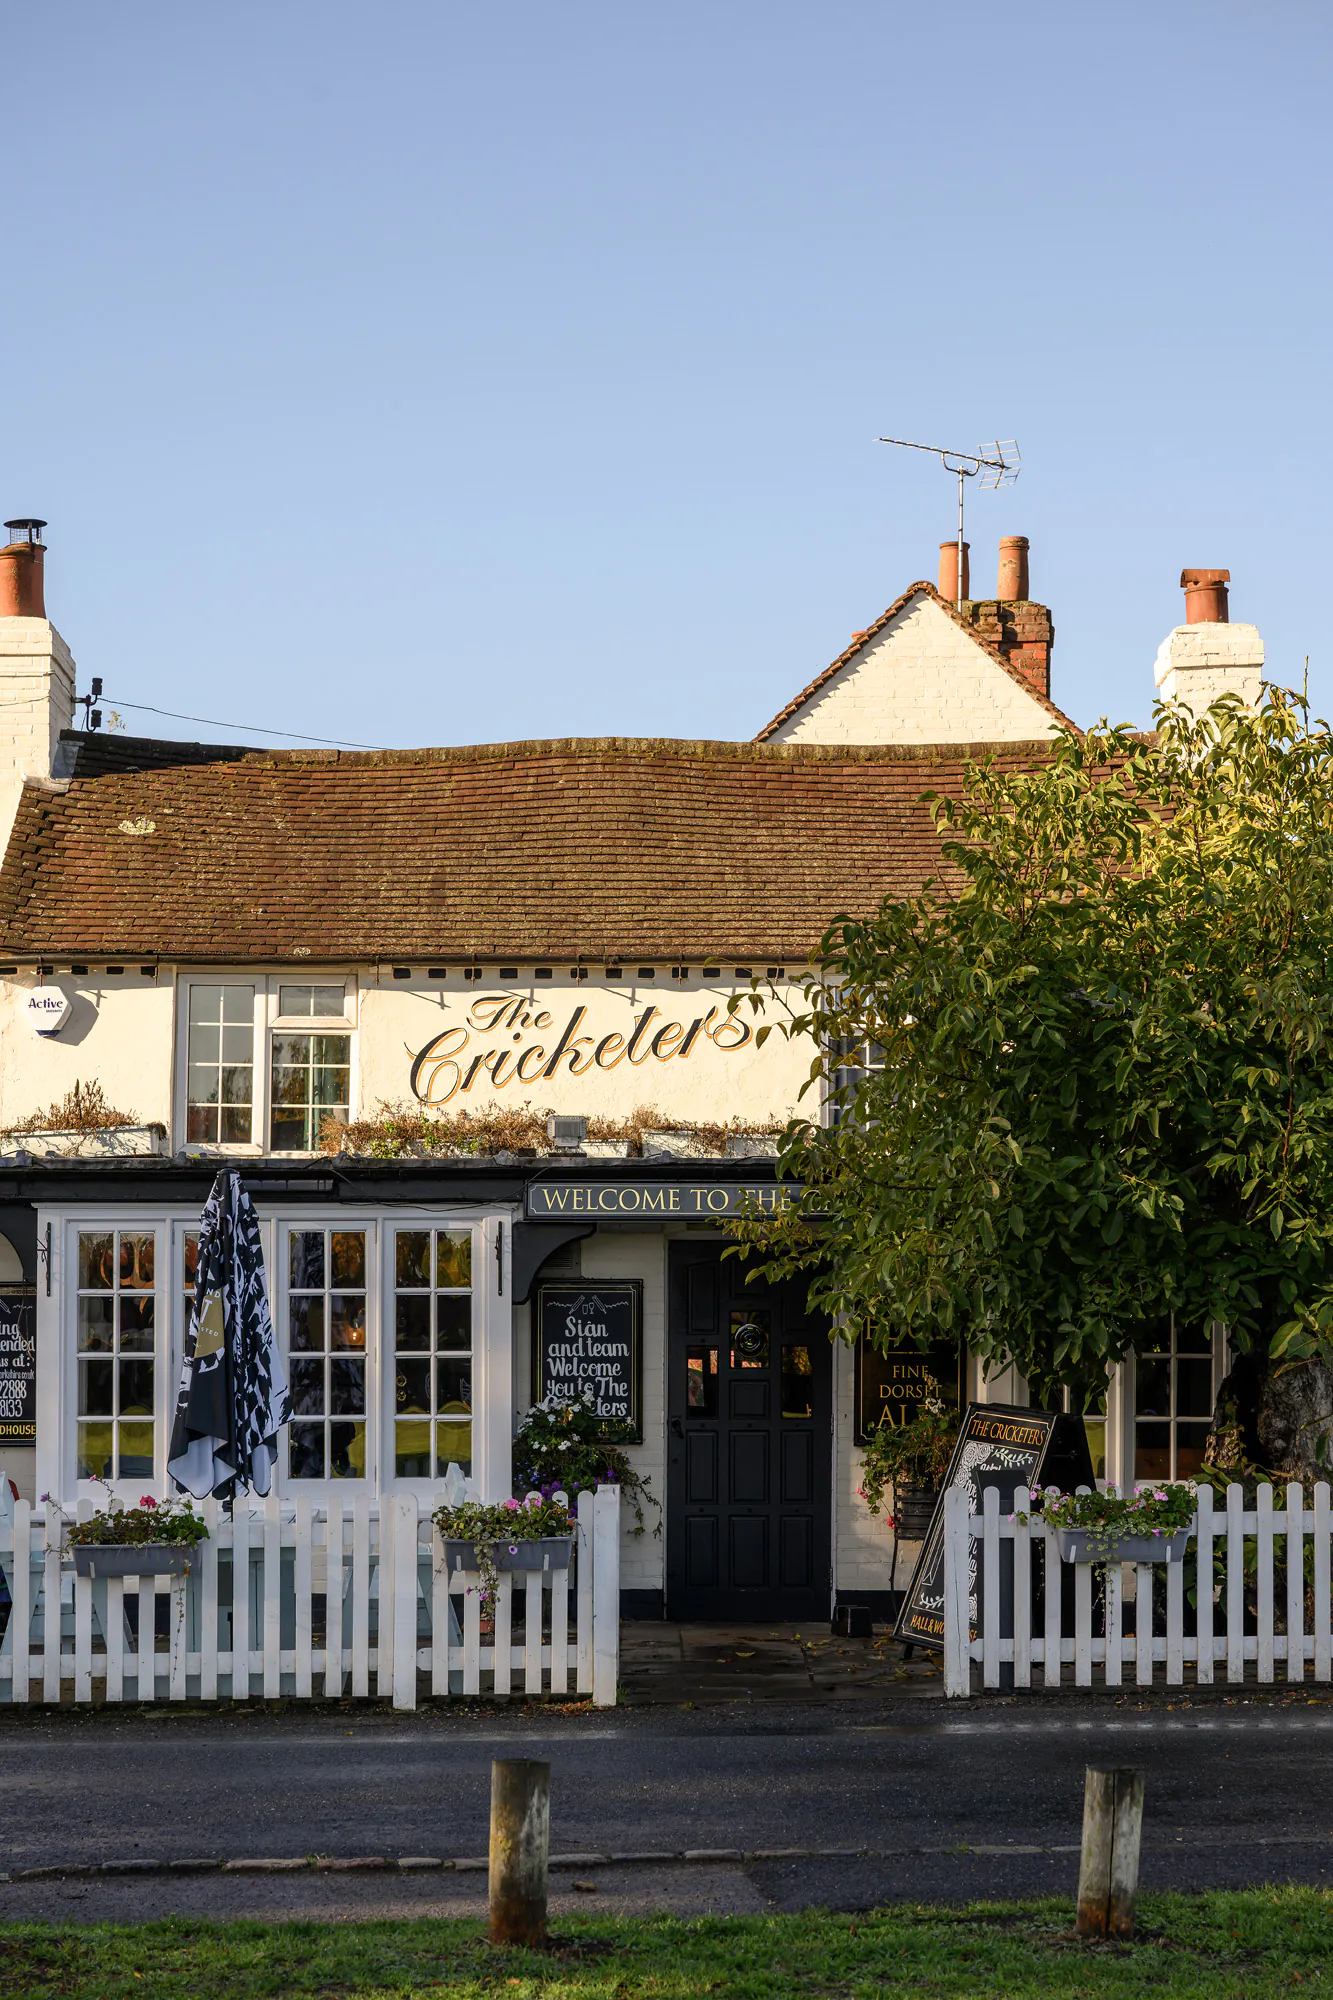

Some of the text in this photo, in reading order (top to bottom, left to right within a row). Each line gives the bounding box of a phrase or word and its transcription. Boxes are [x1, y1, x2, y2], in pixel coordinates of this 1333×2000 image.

[28, 997, 63, 1009] Active
[466, 994, 553, 1031] The
[404, 1005, 754, 1109] Cricketers
[541, 1188, 681, 1211] WELCOME
[690, 1188, 729, 1211] TO
[738, 1188, 792, 1212] THE
[564, 1316, 609, 1338] Siân
[548, 1338, 630, 1357] and team
[546, 1357, 622, 1377] Welcome
[546, 1376, 629, 1397] you to The
[970, 1419, 1046, 1446] THE CRICKETERS
[910, 1614, 928, 1631] HALL
